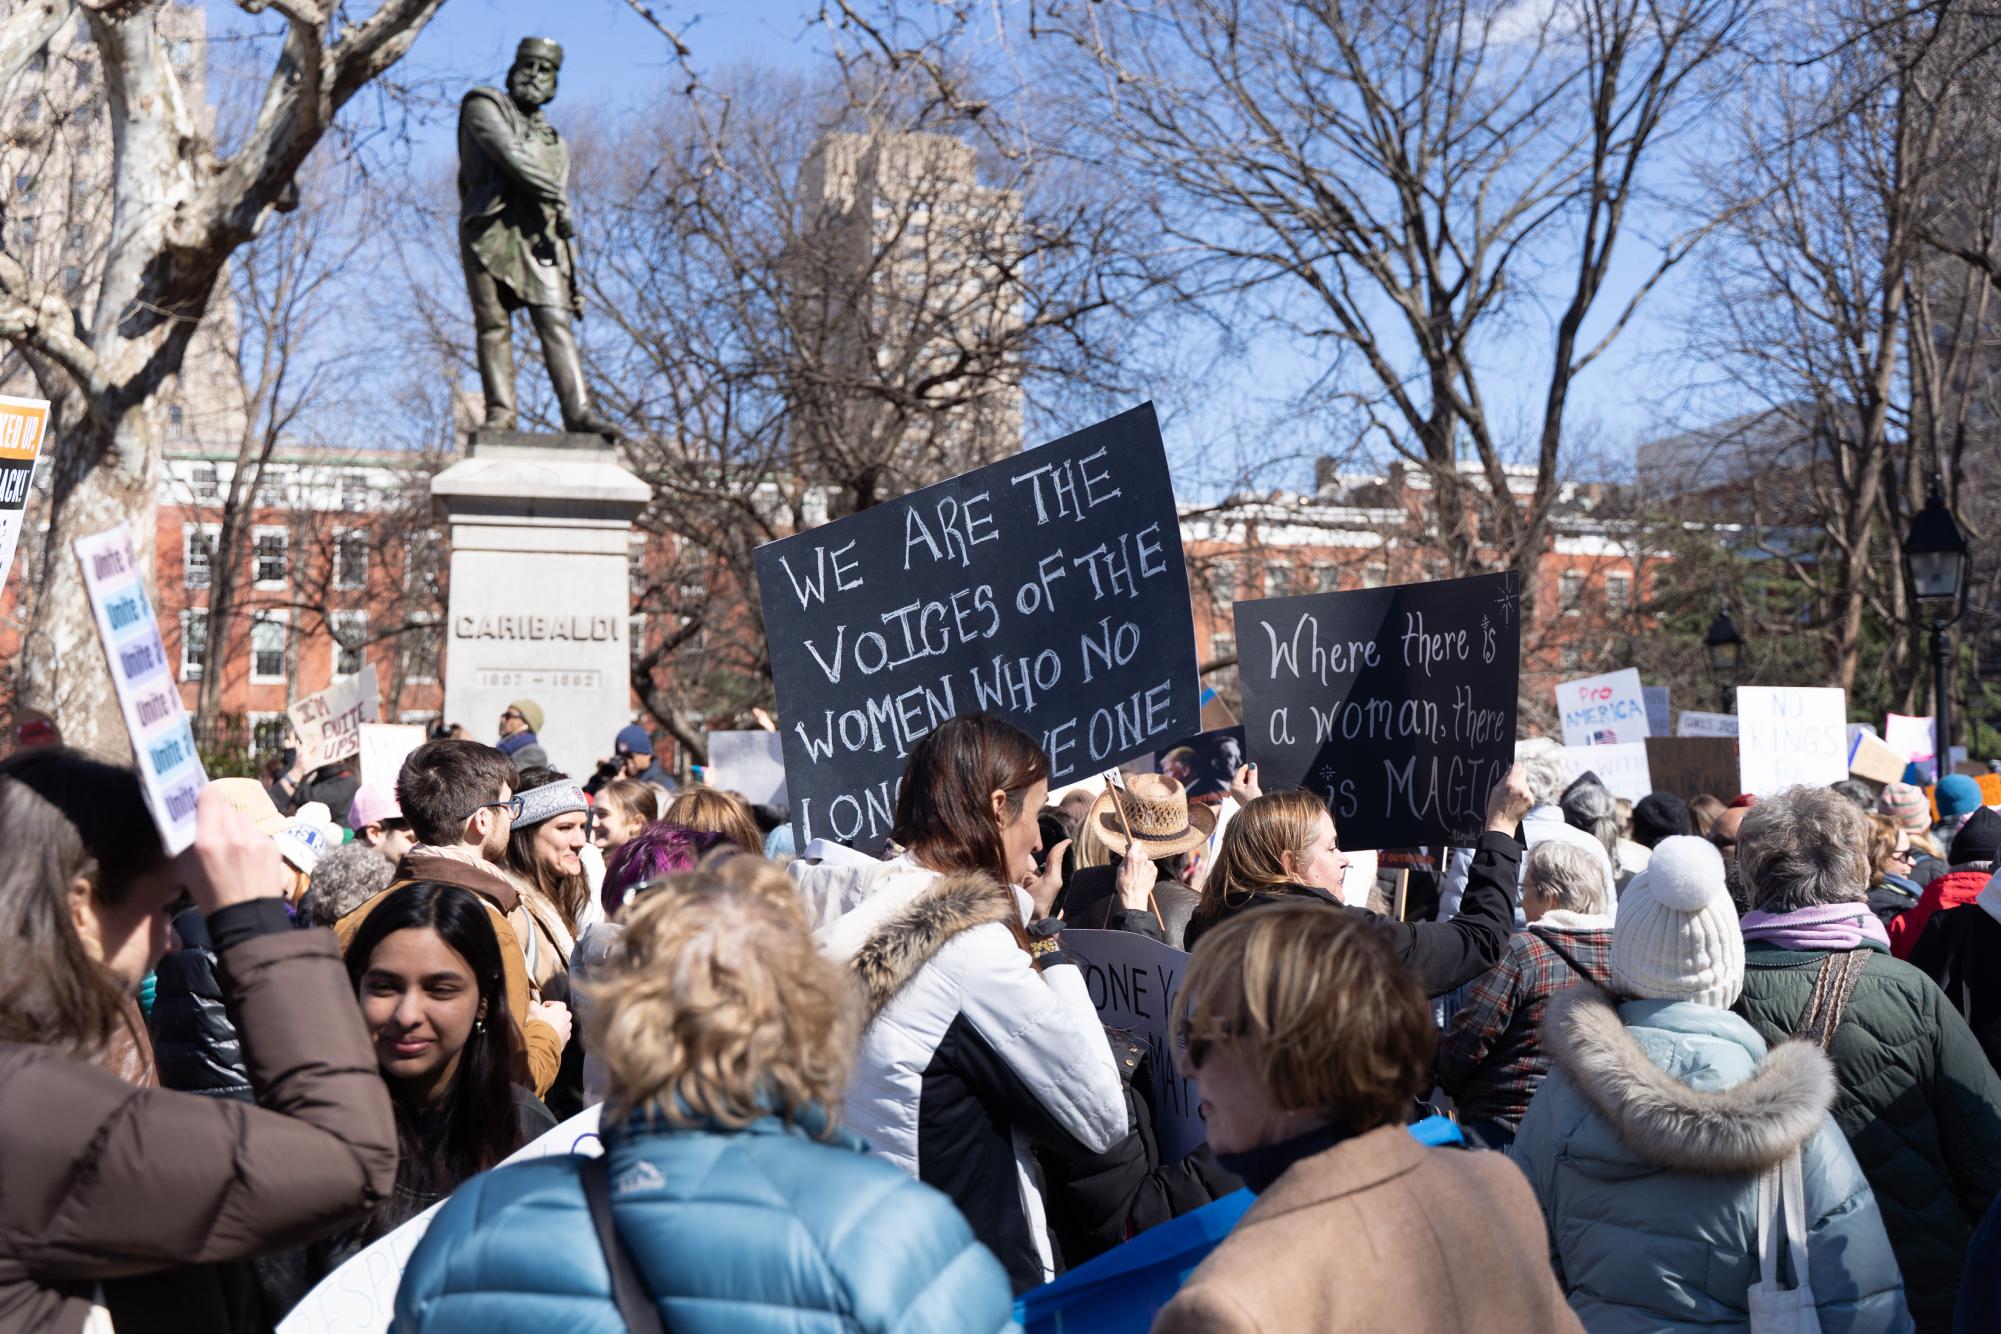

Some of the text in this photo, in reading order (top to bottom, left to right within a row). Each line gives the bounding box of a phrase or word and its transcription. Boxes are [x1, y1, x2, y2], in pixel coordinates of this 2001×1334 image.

[0, 469, 27, 503] ACK!
[779, 446, 1122, 611] WE ARE THE
[93, 547, 125, 581] Unite
[106, 596, 140, 630] Unite
[804, 585, 1000, 684] VOICES
[1074, 521, 1167, 601] THE
[456, 614, 619, 641] GARIBALDI
[120, 644, 155, 679] Unite
[1260, 611, 1498, 686] Where there is
[795, 616, 1140, 764] WOMEN WHO NO
[1772, 689, 1803, 718] NO
[136, 692, 169, 727] Unite
[296, 696, 331, 724] I'M
[1089, 679, 1177, 761] ONE.
[1270, 685, 1504, 748] a woman, there
[1565, 699, 1643, 727] AMERICA
[1750, 722, 1841, 757] KINGS
[150, 740, 184, 775] Unite
[1319, 765, 1358, 818] is
